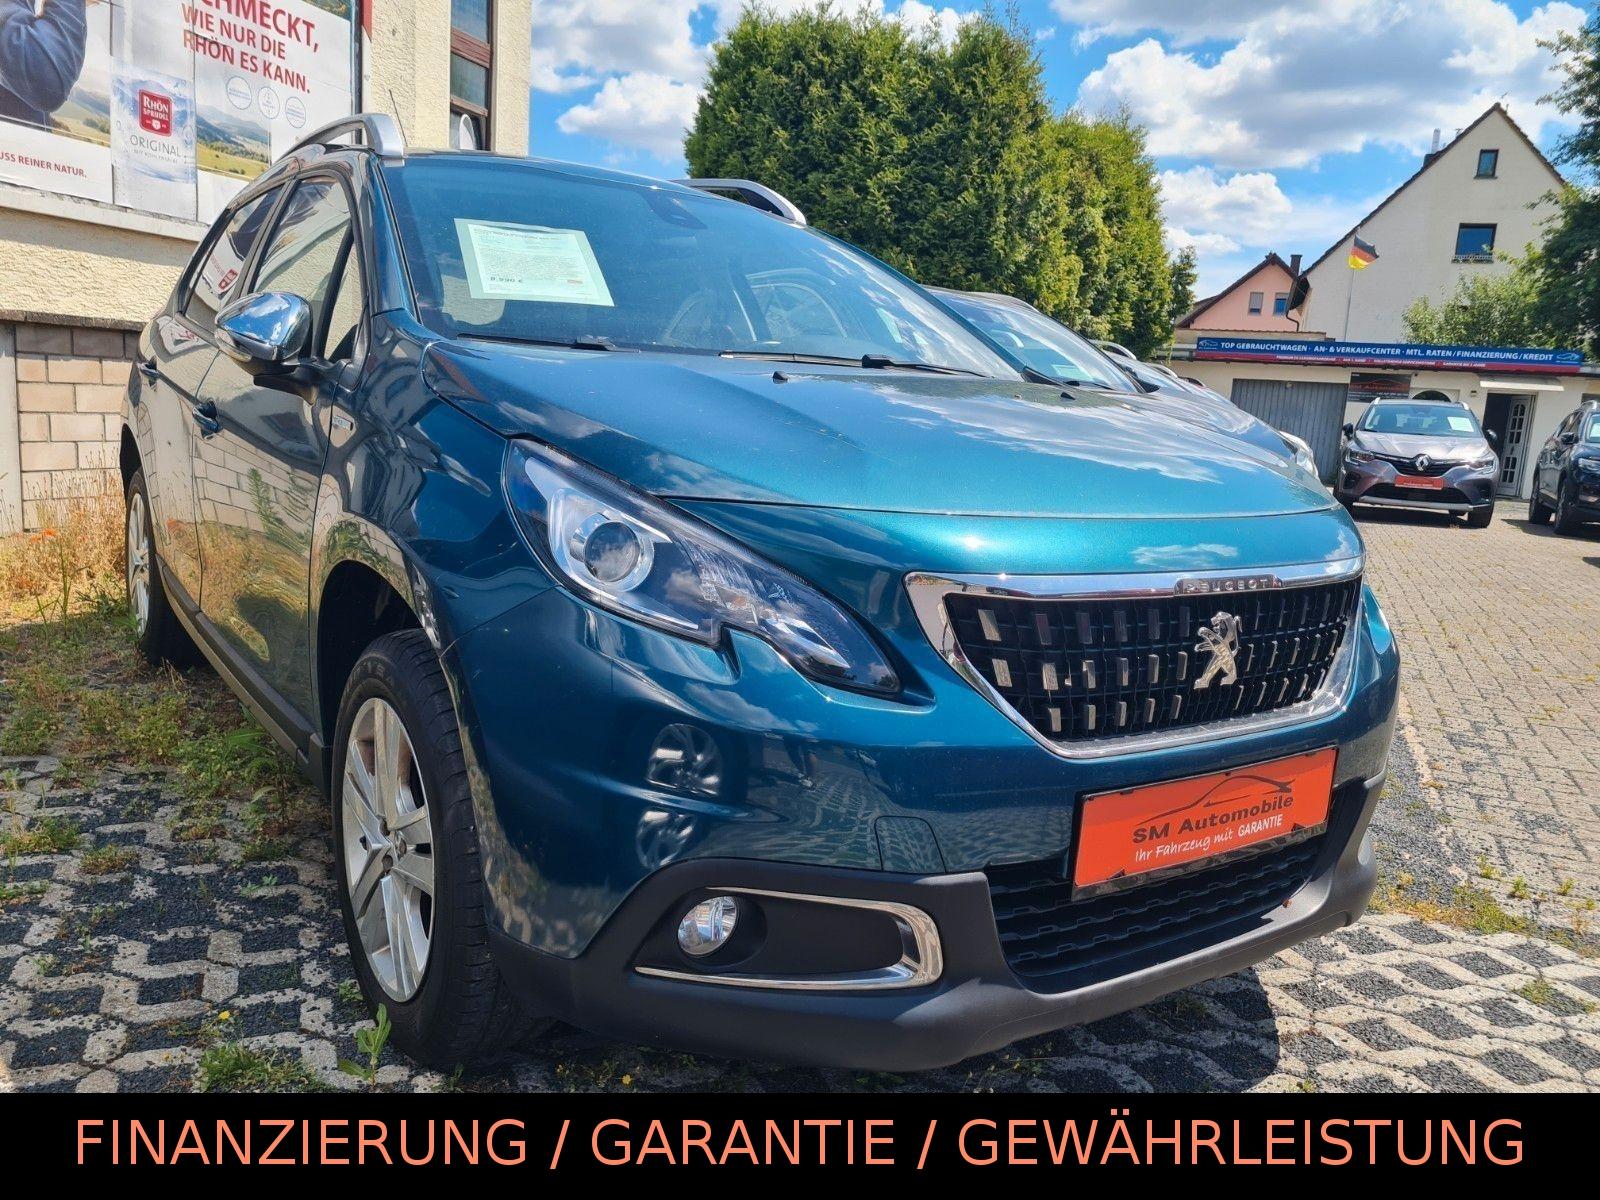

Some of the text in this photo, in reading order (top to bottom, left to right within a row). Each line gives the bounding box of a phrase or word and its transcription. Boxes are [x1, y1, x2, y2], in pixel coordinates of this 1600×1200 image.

[181, 3, 286, 60] WIE NUR DIE
[202, 0, 319, 53] MECKT,
[183, 29, 235, 66] RHÖN
[240, 51, 259, 73] ES
[263, 60, 310, 94] KANN.
[143, 95, 169, 114] RHÖN
[18, 155, 52, 170] REINER
[54, 163, 87, 178] NATUR.
[129, 134, 182, 158] ORIGINAL
[1220, 342, 1235, 350] TOP
[1236, 343, 1308, 352] GEBRAUCHTWAGEN
[1337, 346, 1401, 355] VERKAUFCENTER
[1406, 348, 1425, 356] MTL.
[1132, 794, 1294, 844] SM Automobile
[1135, 849, 1152, 863] Ihr
[1155, 836, 1211, 858] Fahrzeug
[1214, 826, 1234, 842] mit
[1237, 813, 1284, 838] GARANTIE
